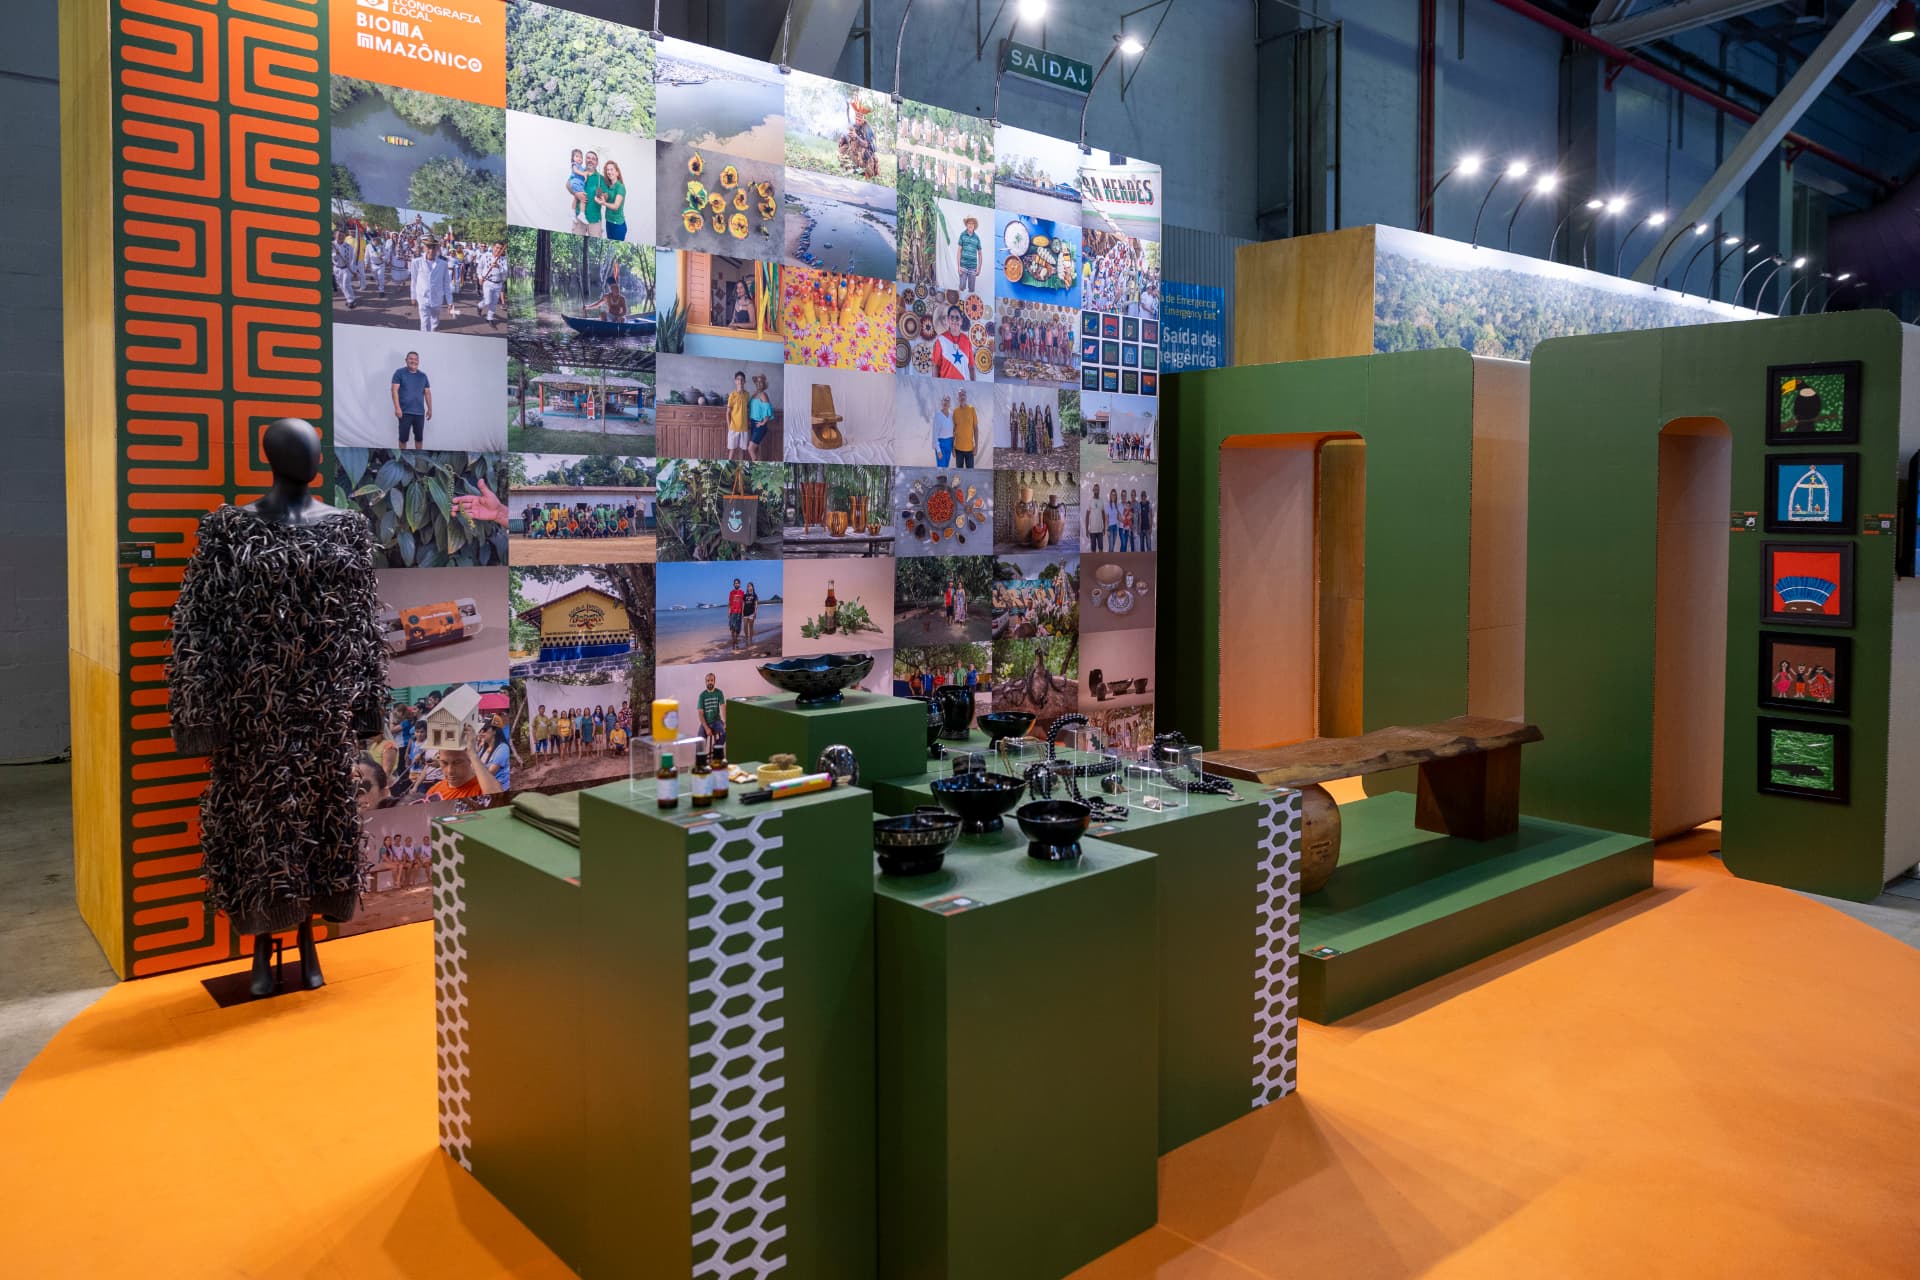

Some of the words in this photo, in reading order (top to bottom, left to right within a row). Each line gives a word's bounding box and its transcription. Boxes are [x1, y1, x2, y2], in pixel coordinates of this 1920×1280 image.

[392, 0, 482, 24] ICONOGRAFIA
[393, 4, 433, 22] LOCAL
[356, 11, 424, 41] BIOMA
[1011, 49, 1077, 83] SAÍDA
[1101, 178, 1155, 206] MENDES
[1163, 326, 1198, 345] Saída
[1201, 330, 1217, 347] de
[1160, 348, 1217, 369] ergência
